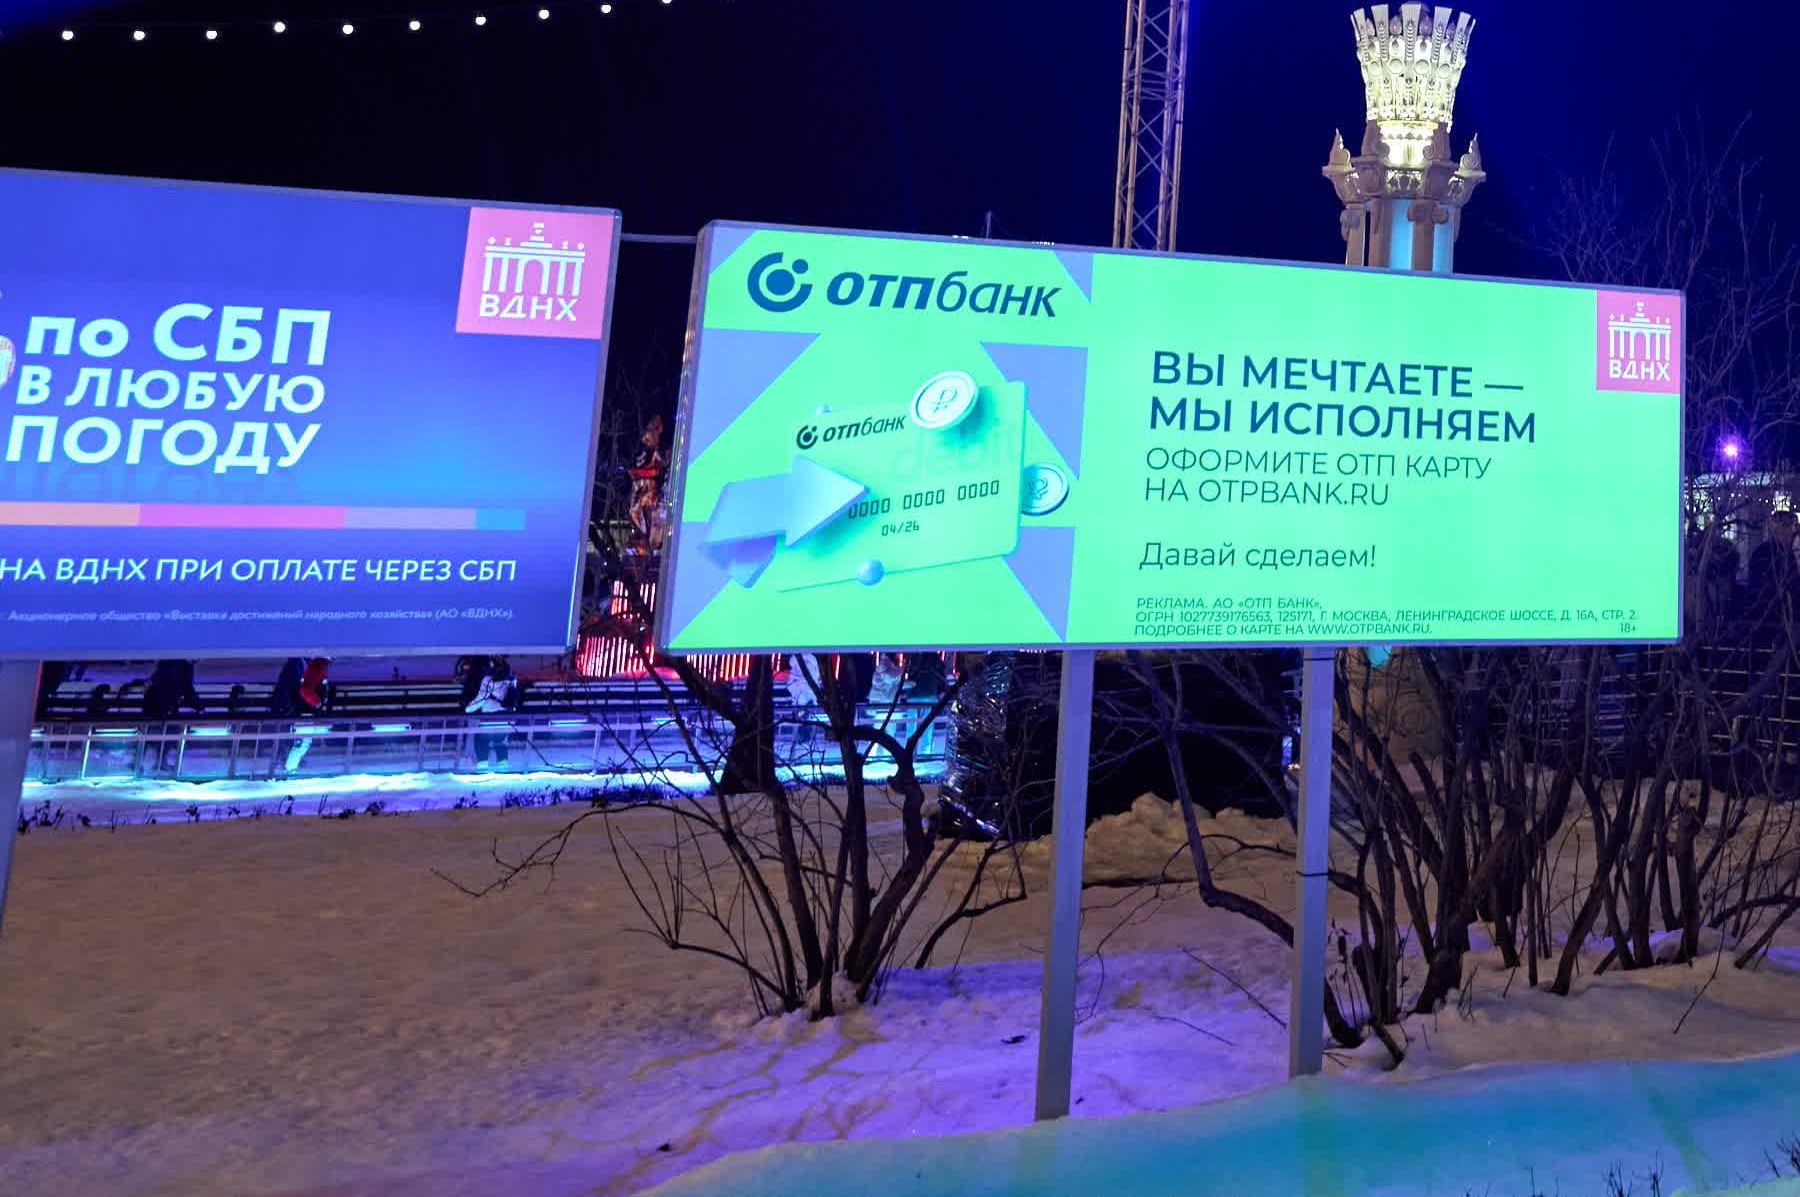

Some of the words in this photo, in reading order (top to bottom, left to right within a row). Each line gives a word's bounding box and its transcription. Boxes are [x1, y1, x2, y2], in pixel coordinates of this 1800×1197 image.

[479, 293, 578, 322] ВДНХ
[24, 316, 129, 358] по
[153, 303, 332, 366] СБП
[1153, 350, 1225, 387] ВЫ
[1243, 354, 1473, 398] МЕЧТАЕТЕ
[1609, 359, 1671, 382] ВДНХ
[16, 365, 52, 405] В
[64, 367, 325, 414] ЛЮБУЮ
[1150, 396, 1232, 433] МЫ
[1250, 400, 1536, 443] ИСПОЛНЯЕМ
[5, 415, 322, 475] ПОГОДУ
[1146, 447, 1329, 475] ОФОРМИТЕ
[1337, 453, 1395, 476] ОТП
[1406, 455, 1492, 479] КАРТУ
[848, 497, 891, 519] 0000
[903, 489, 945, 510] 0000
[957, 479, 1000, 501] 0000
[1146, 477, 1189, 502] НА
[1198, 479, 1389, 506] OTPBANK.RU
[881, 519, 920, 537] 04/26
[0, 558, 46, 580] НА
[55, 558, 149, 583] ВДНХ
[155, 559, 224, 581] ПРИ
[231, 559, 358, 581] ОПЛАТЕ
[365, 559, 451, 581] ЧЕРЕЗ
[459, 560, 517, 581] СБП
[1138, 541, 1236, 571] Давай
[1245, 544, 1376, 571] сделаем!
[1135, 611, 1174, 623] ОГРН
[1180, 610, 1273, 623] 1027739176563,
[1279, 610, 1316, 623] 125171,
[1332, 610, 1391, 623] МОСКВА,
[1395, 610, 1505, 623] ЛЕНИНГРАДСКОЕ
[1510, 610, 1557, 622] ШОССЕ,
[1576, 609, 1598, 622] 16А,
[1601, 609, 1626, 621] СТР.
[1136, 597, 1208, 610] РЕКЛАМА.
[1212, 597, 1234, 609] АО
[1134, 624, 1223, 638] ПОДРОБНЕЕ
[1226, 624, 1237, 635] О
[1240, 624, 1282, 635] КАРТЕ
[1285, 624, 1304, 634] НА
[1619, 622, 1637, 634] 18+
